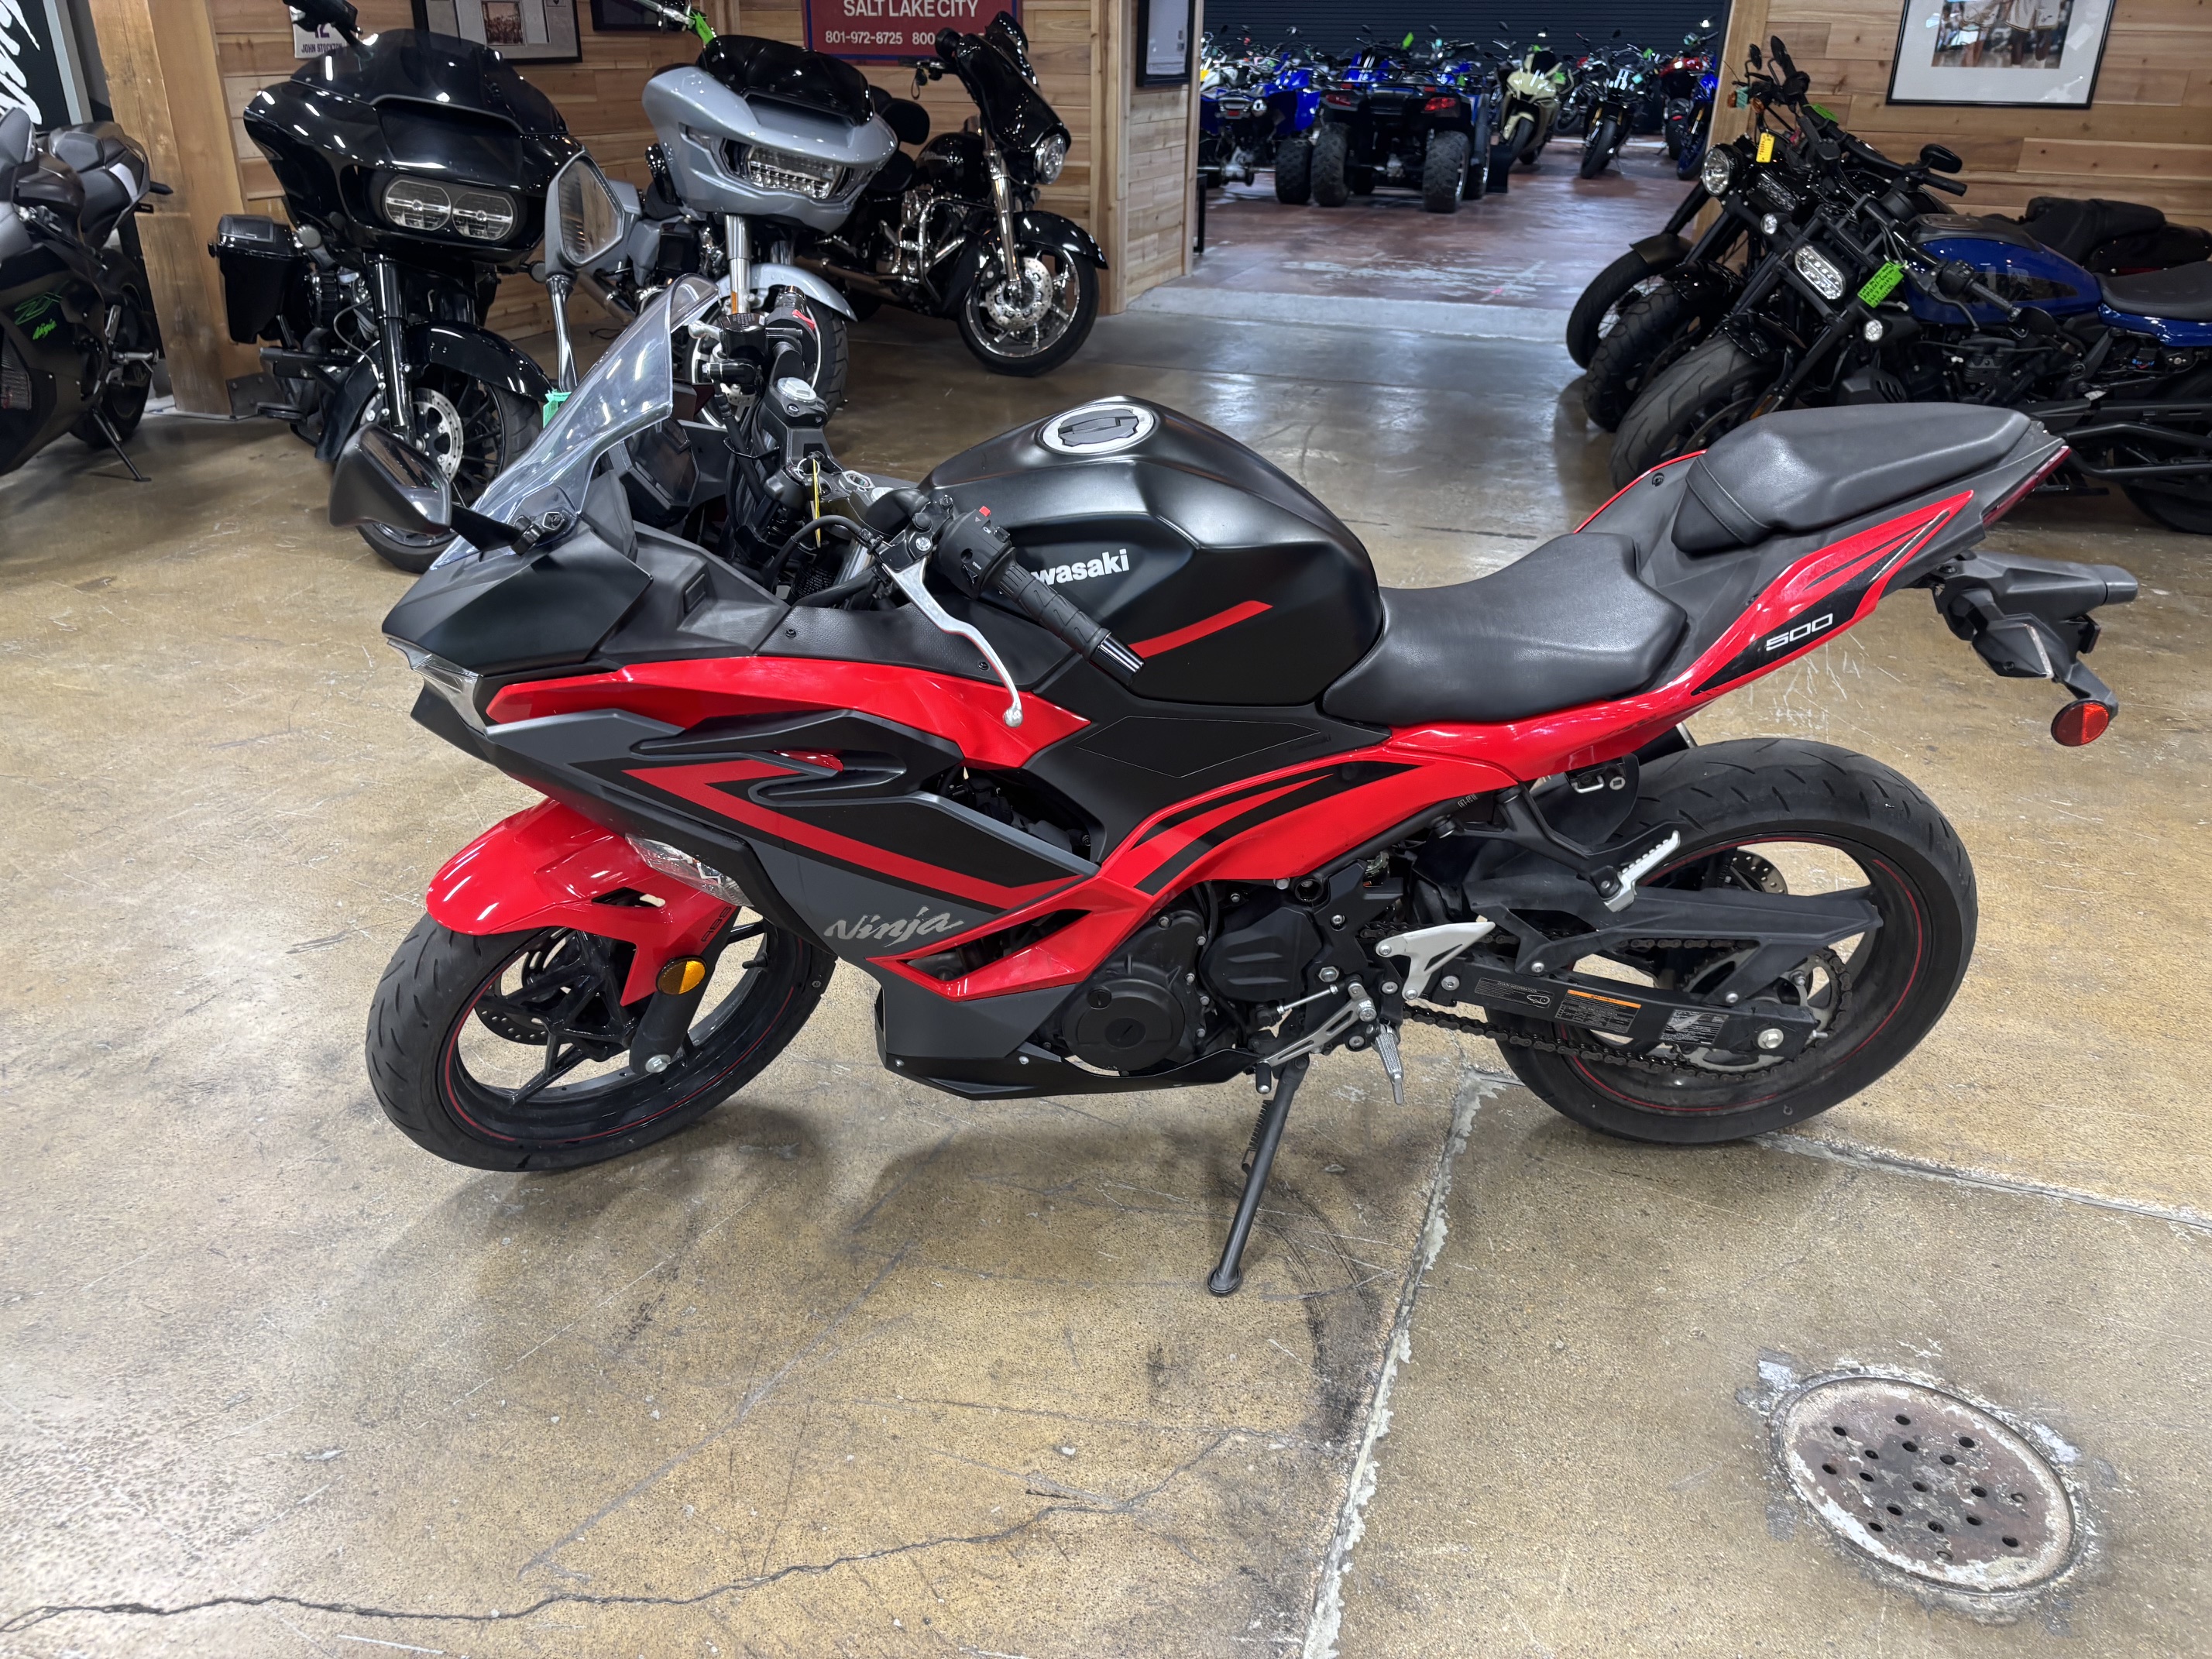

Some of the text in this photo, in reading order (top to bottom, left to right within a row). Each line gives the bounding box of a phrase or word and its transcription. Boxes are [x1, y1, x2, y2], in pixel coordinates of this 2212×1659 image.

[843, 0, 978, 17] SALT LAKE CITY
[301, 43, 315, 53] JOHN
[825, 31, 903, 45] 801-972-8725
[1766, 613, 1833, 651] 500
[701, 906, 732, 943] ABS
[823, 906, 964, 948] Ninja
